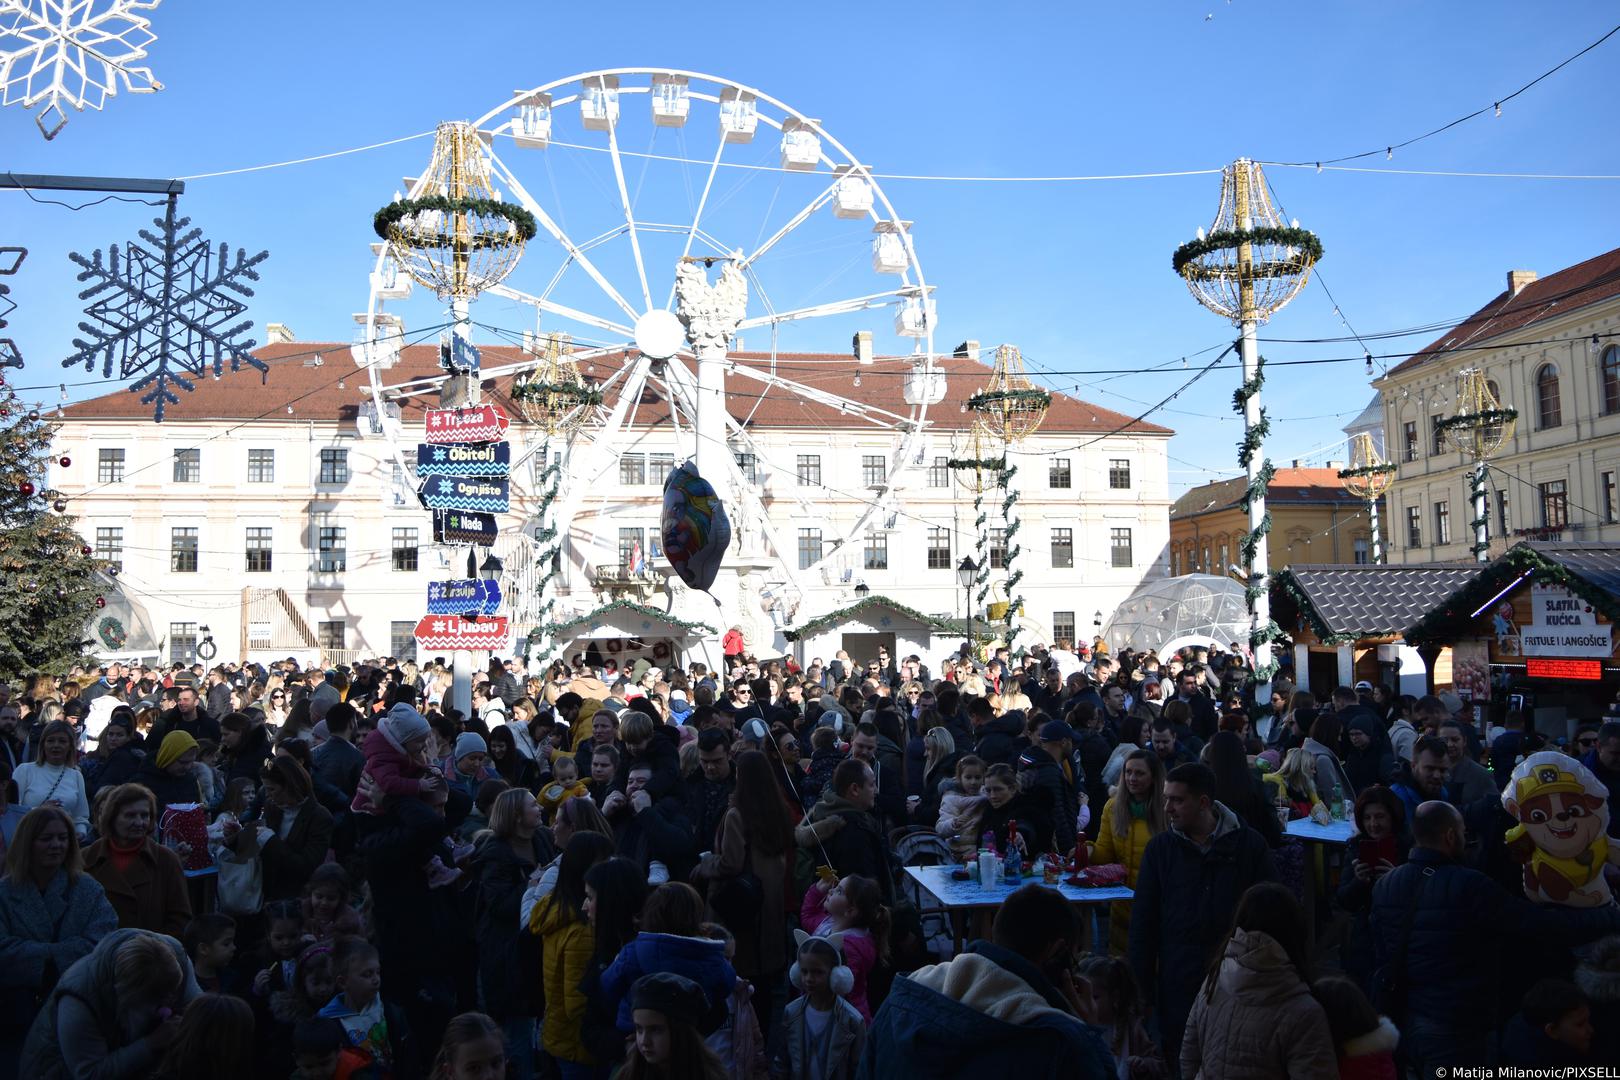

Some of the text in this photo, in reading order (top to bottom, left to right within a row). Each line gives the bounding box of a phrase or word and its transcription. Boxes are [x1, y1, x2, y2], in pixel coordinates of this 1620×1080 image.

[449, 448, 495, 462] Obitelj
[458, 483, 501, 496] Ognjište
[461, 516, 482, 531] Nada
[1546, 600, 1580, 611] SLATKA
[1546, 612, 1581, 625] KUĆICA
[447, 619, 499, 636] Ljubav
[1524, 633, 1607, 647] FRITULE I LANGOŠICE
